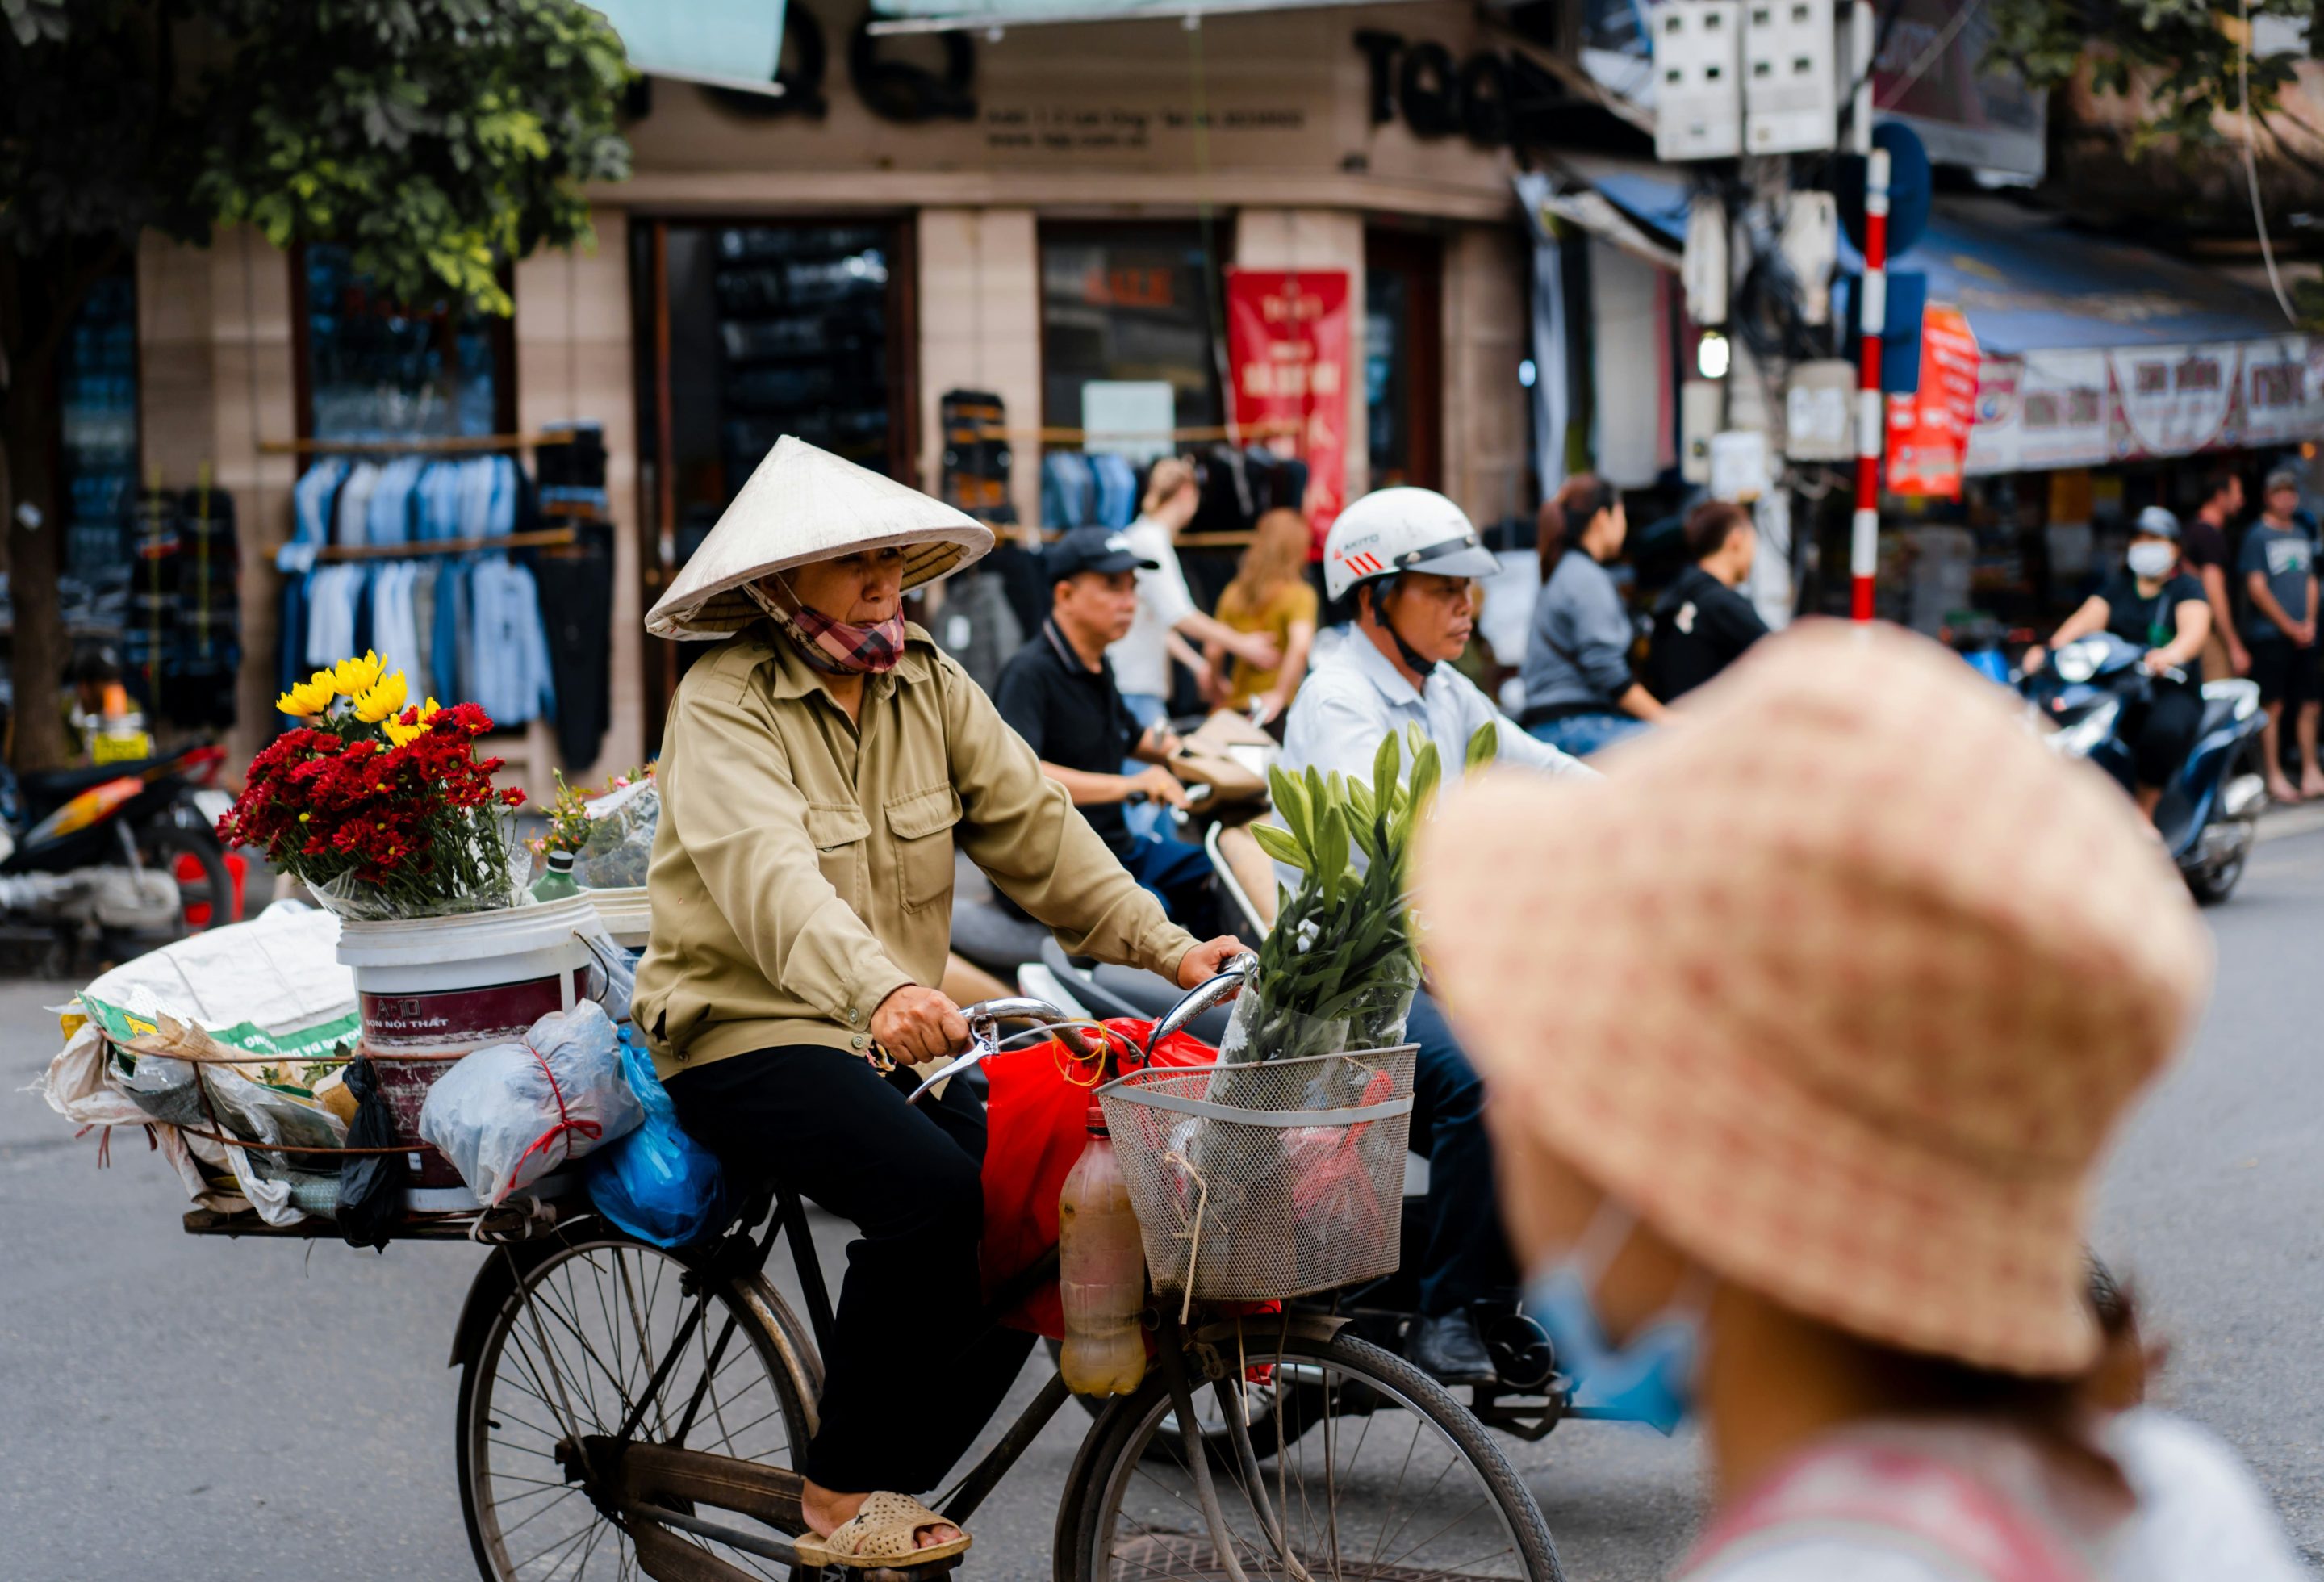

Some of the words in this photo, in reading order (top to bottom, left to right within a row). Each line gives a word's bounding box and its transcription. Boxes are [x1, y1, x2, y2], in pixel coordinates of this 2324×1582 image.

[376, 998, 422, 1019] A-10
[385, 1019, 407, 1030] NỘI
[409, 1016, 449, 1028] THẤT
